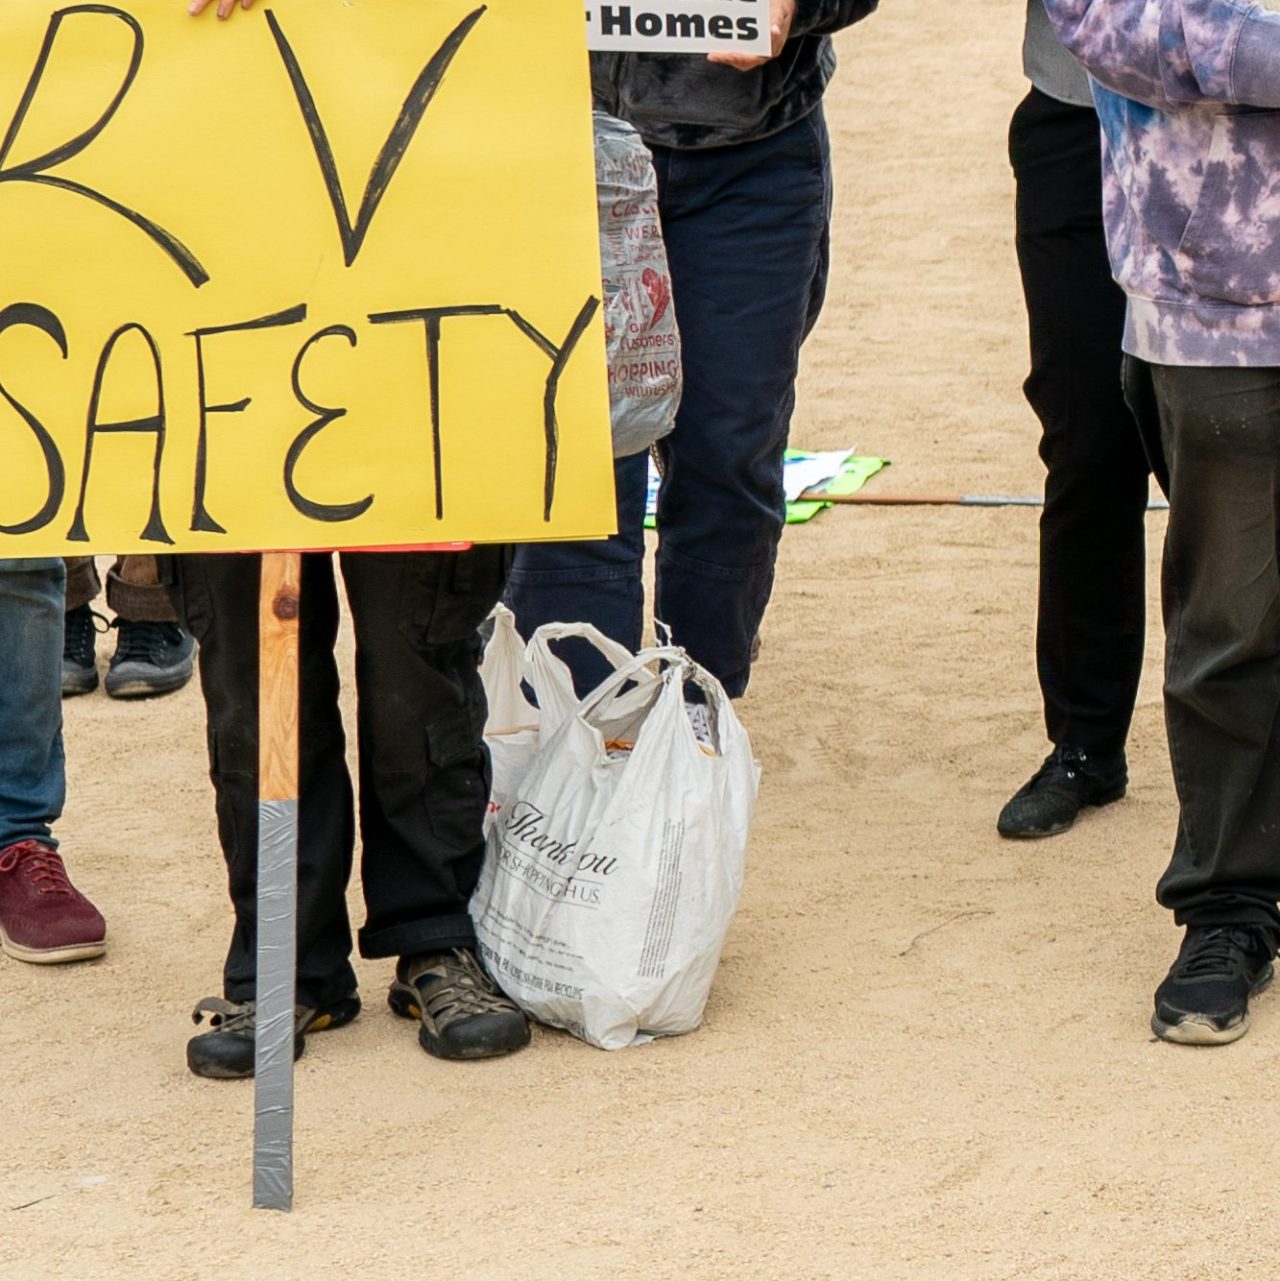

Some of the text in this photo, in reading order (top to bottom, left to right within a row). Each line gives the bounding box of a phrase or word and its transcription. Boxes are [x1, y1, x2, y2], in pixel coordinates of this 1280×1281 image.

[600, 5, 760, 41] Homes
[0, 3, 488, 289] RV
[0, 294, 601, 545] SAFETY
[505, 800, 619, 876] Thank ou
